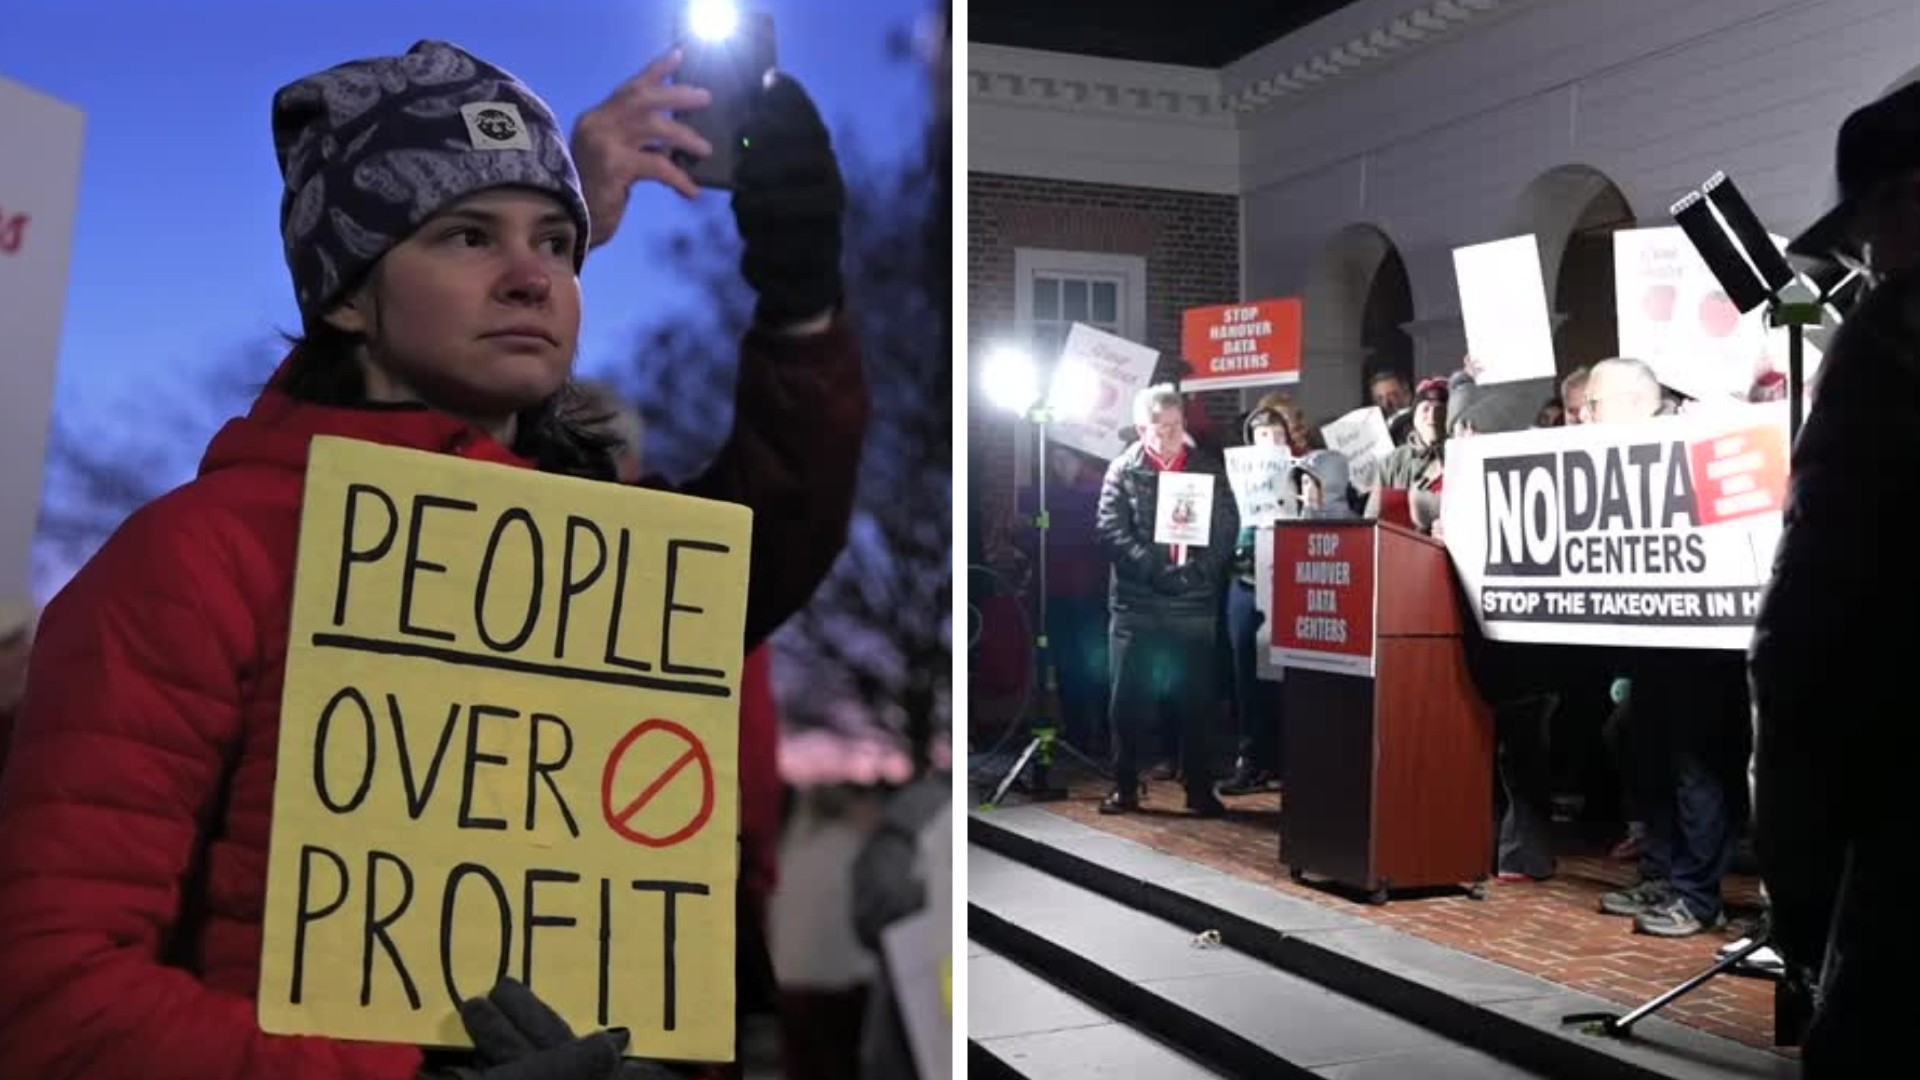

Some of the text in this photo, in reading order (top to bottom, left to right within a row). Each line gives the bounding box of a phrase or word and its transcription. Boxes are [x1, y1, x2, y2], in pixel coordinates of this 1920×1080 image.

[1223, 306, 1259, 323] STOP
[1209, 321, 1273, 340] HANOVER
[1223, 338, 1258, 355] DATA
[1210, 352, 1270, 372] CENTERS
[1486, 441, 1702, 565] NO DATA
[1308, 533, 1340, 557] STOP
[1565, 533, 1707, 574] CENTERS
[332, 483, 730, 679] PEOPLE
[1295, 561, 1351, 585] HANOVER
[1308, 588, 1337, 613] DATA
[1483, 591, 1761, 617] STOP THE TAKEOVER IN H
[1295, 616, 1347, 643] CENTERS
[312, 686, 580, 838] OVER
[289, 844, 711, 1032] PROFIT
